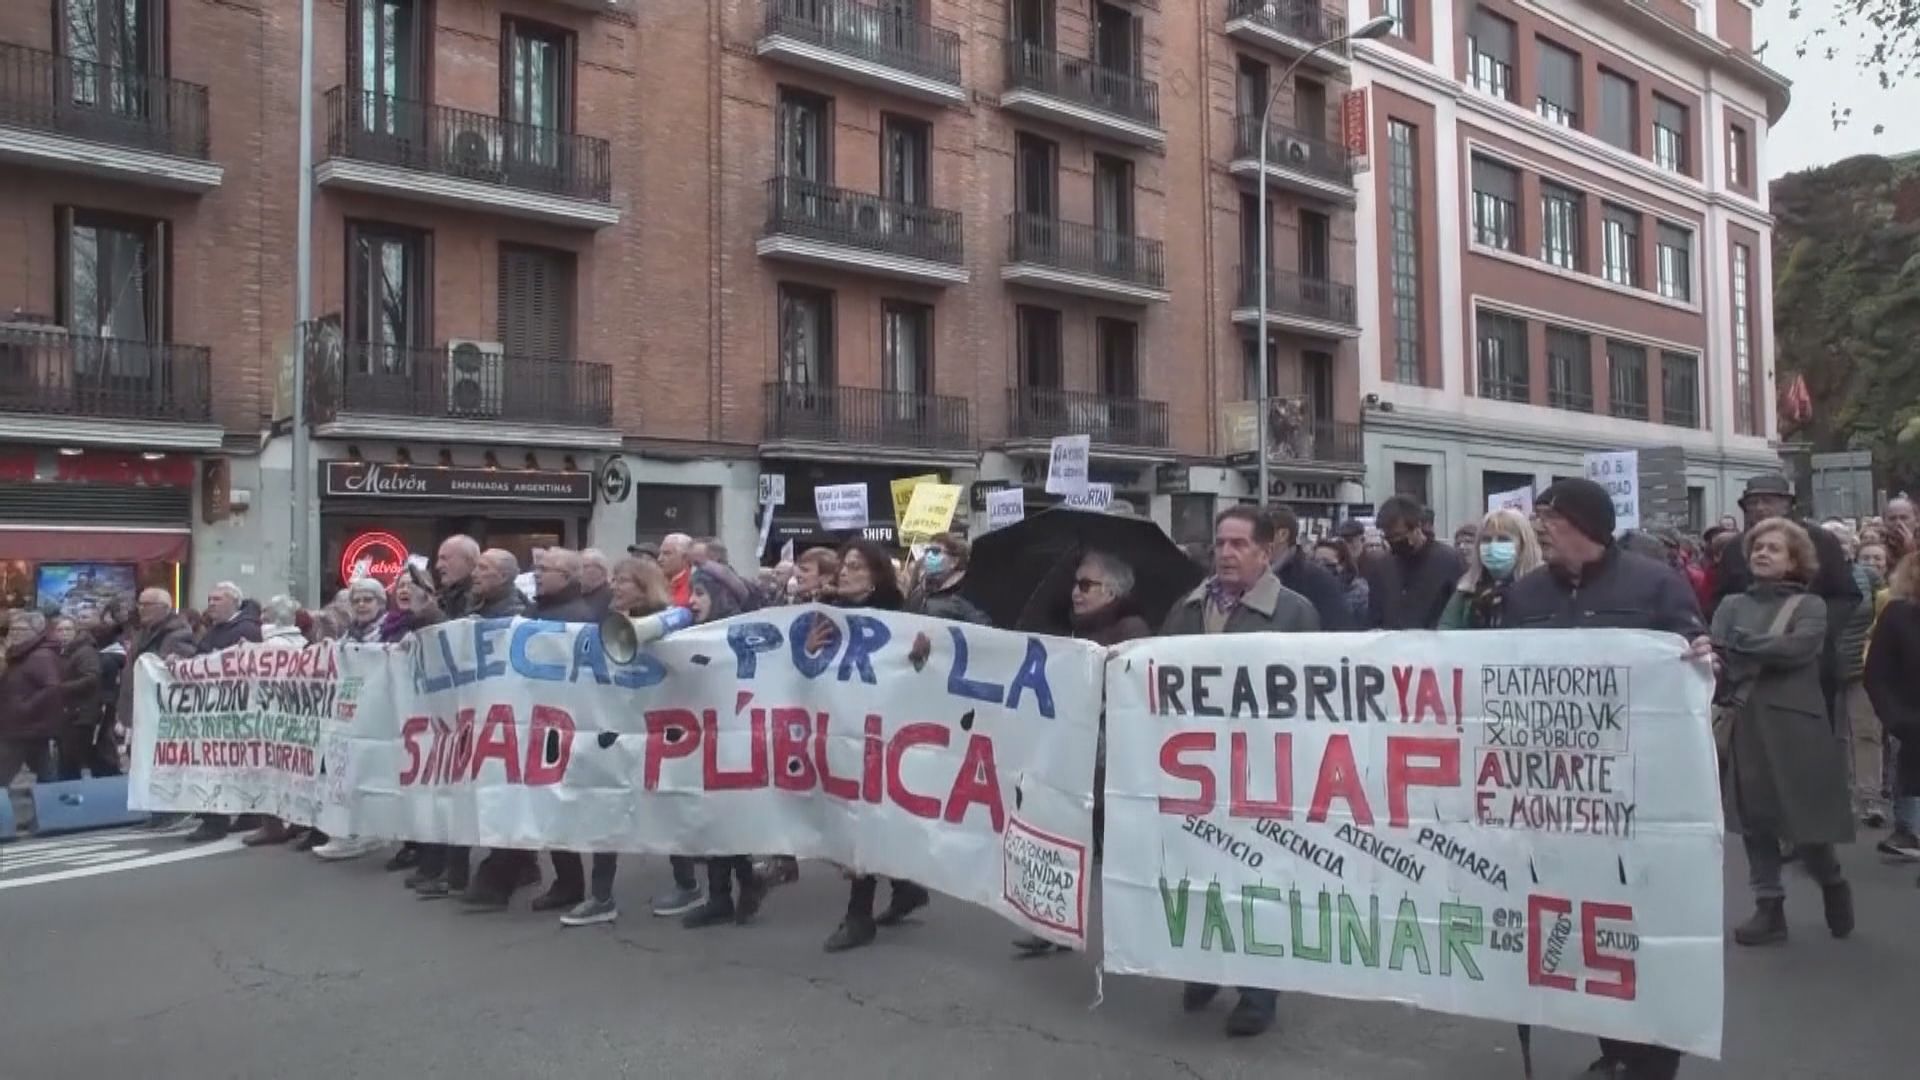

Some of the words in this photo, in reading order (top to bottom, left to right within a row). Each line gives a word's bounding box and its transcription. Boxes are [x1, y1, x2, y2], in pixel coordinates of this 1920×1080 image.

[451, 480, 509, 491] EMPANADAS
[514, 483, 572, 493] ARGENTINAS
[862, 528, 893, 541] SHIFU
[727, 610, 892, 685] POR
[947, 625, 1056, 719] LA
[1483, 667, 1619, 697] PLATAFORMA
[1391, 664, 1465, 733] YA!
[1484, 700, 1584, 731] SANIDAD
[1587, 702, 1627, 731] VK
[1510, 730, 1529, 747] LO
[644, 691, 1005, 833] PÚBLICA
[1157, 731, 1462, 829] SUAP
[1509, 795, 1636, 837] MONTSENY
[1181, 814, 1264, 868] SERVICIO
[1159, 876, 1484, 981] VACUNAR
[1493, 908, 1523, 928] en
[1490, 930, 1524, 953] LOS
[1597, 930, 1641, 952] SALUD
